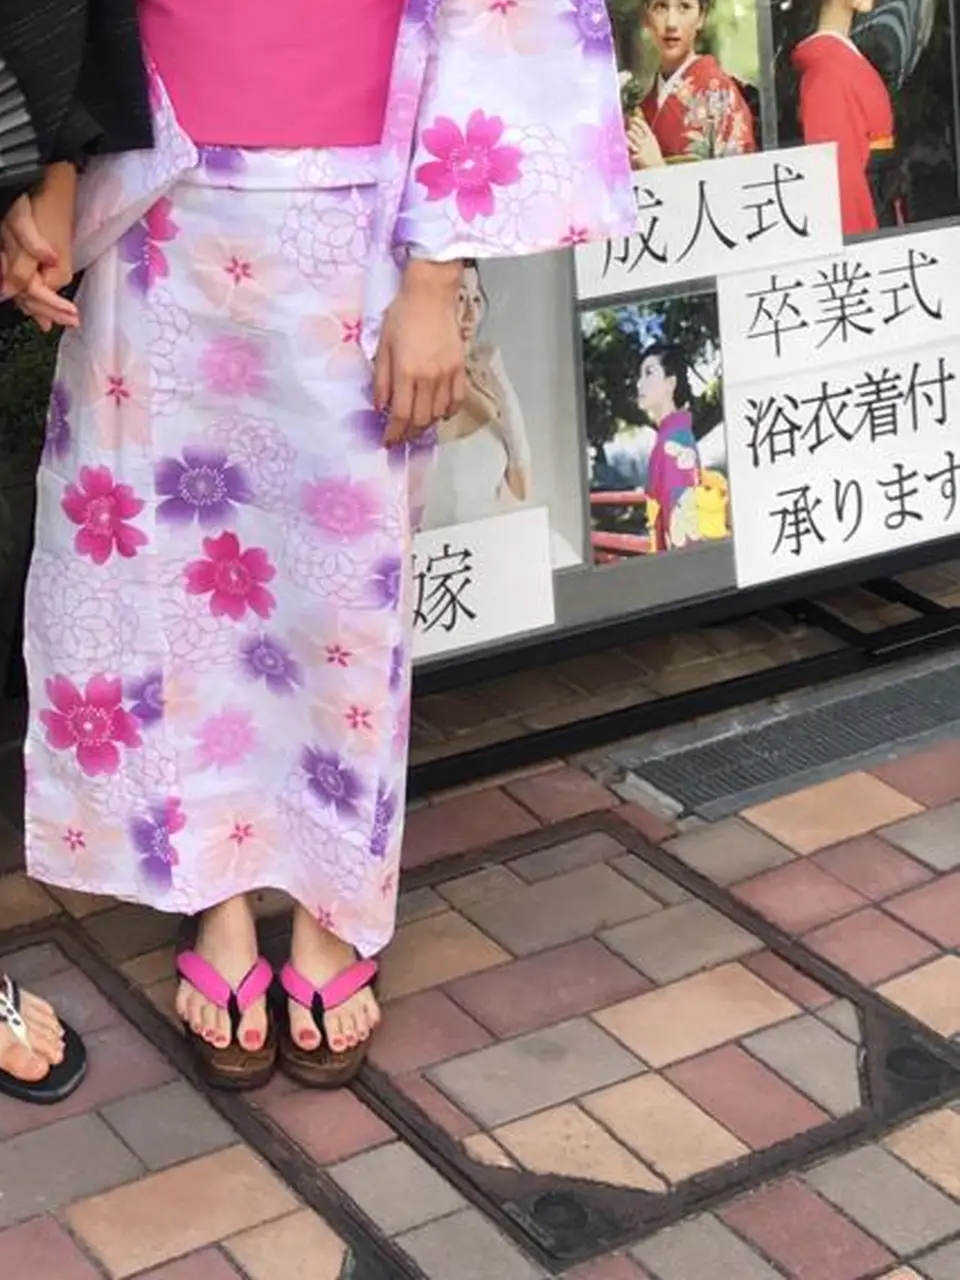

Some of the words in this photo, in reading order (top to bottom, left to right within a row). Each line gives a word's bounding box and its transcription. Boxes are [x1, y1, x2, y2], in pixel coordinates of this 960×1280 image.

[601, 163, 810, 278] 成人式
[745, 248, 943, 358] 卒業式
[743, 356, 956, 468] 浴衣着付
[768, 450, 960, 556] 承ります
